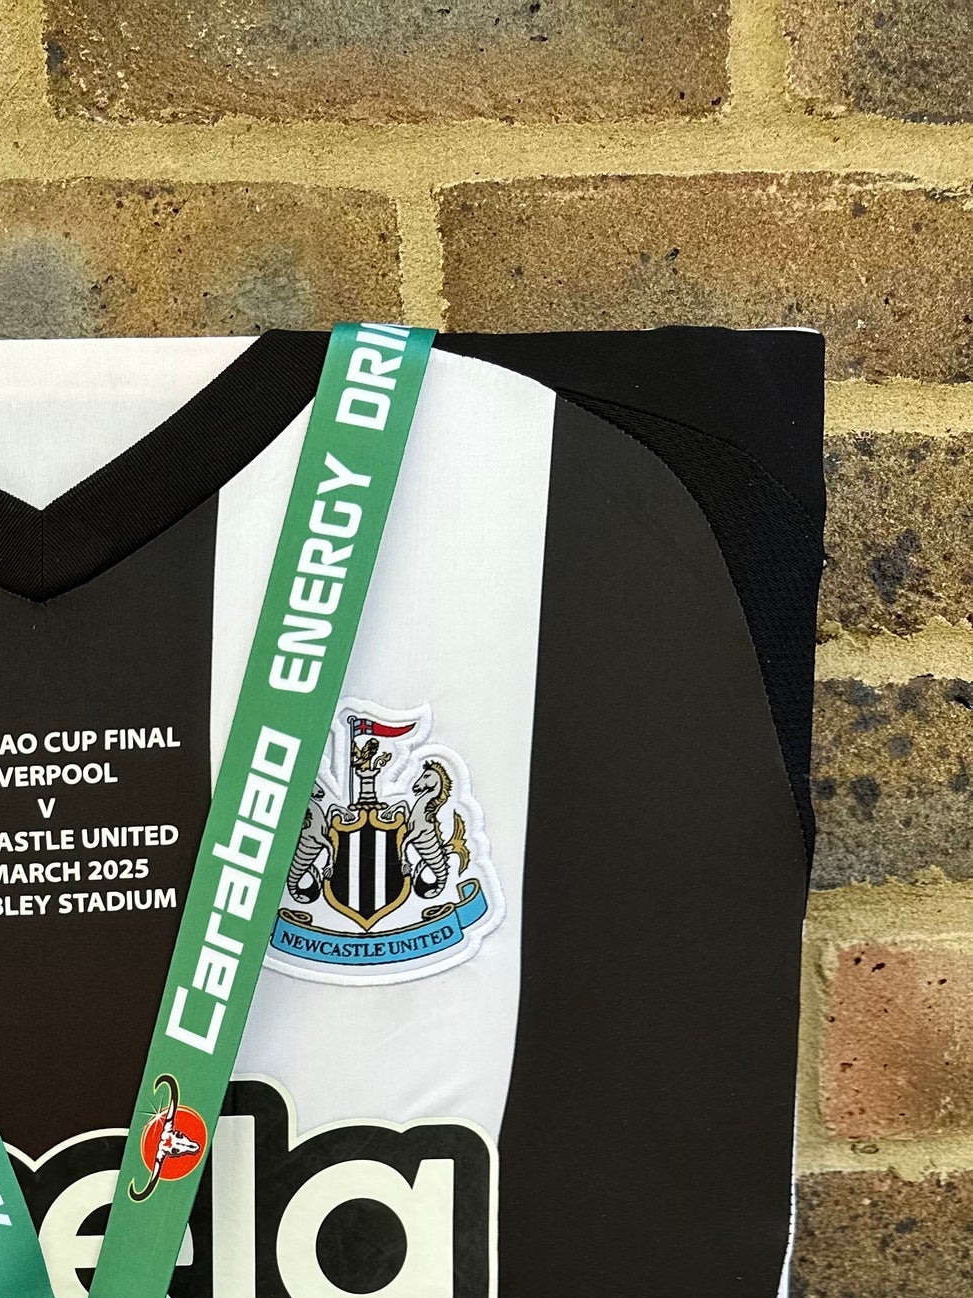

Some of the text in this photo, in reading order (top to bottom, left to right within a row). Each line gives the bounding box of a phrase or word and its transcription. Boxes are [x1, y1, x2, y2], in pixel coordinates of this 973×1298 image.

[44, 730, 97, 753] CUP
[104, 726, 181, 750] FINAL
[165, 725, 301, 1055] Carabao
[268, 451, 372, 693] ENERGY
[37, 798, 56, 819] V
[81, 824, 179, 849] UNITED
[87, 858, 150, 882] 2025
[58, 888, 177, 915] STADIUM
[281, 925, 454, 957] NEWCASTLE UNITED
